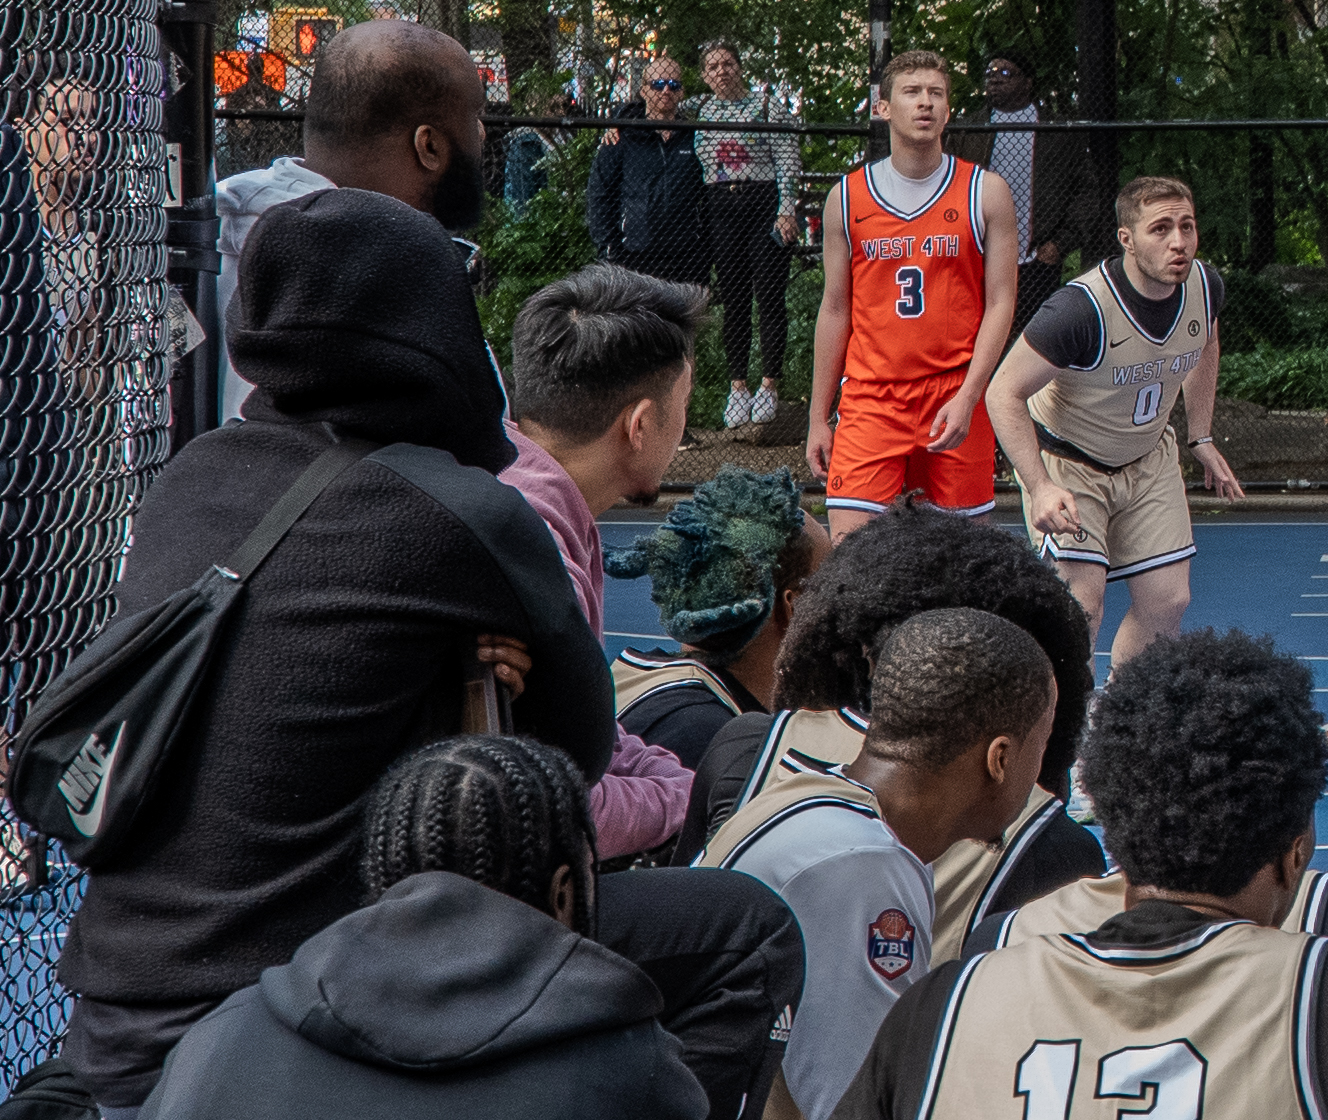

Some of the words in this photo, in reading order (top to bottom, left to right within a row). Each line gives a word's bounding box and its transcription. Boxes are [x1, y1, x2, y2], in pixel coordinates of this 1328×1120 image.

[861, 235, 916, 260] WEST
[920, 234, 959, 257] 4TH
[895, 265, 926, 319] 3
[1112, 358, 1166, 386] WEST
[1131, 382, 1164, 427] 0
[57, 733, 113, 813] NIKE
[876, 941, 909, 958] TBL
